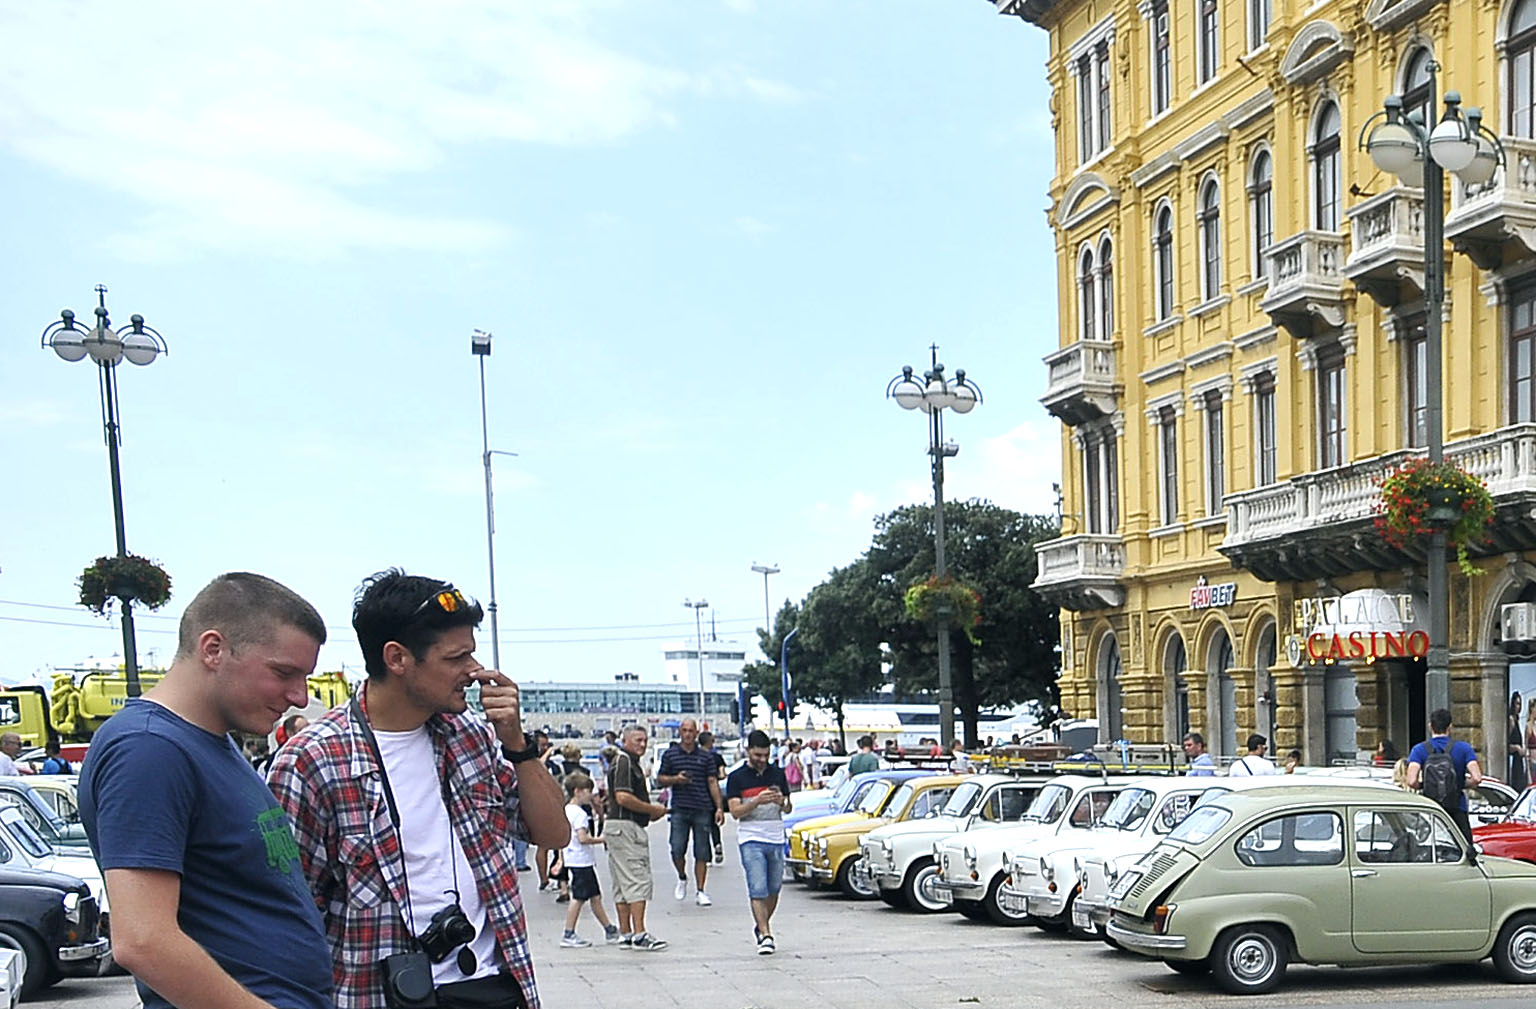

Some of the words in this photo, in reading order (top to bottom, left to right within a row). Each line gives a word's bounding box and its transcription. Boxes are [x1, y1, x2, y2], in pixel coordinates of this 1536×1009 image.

[1190, 583, 1235, 609] FAVBET
[1302, 594, 1414, 627] PALACE
[1308, 630, 1430, 660] CASINO
